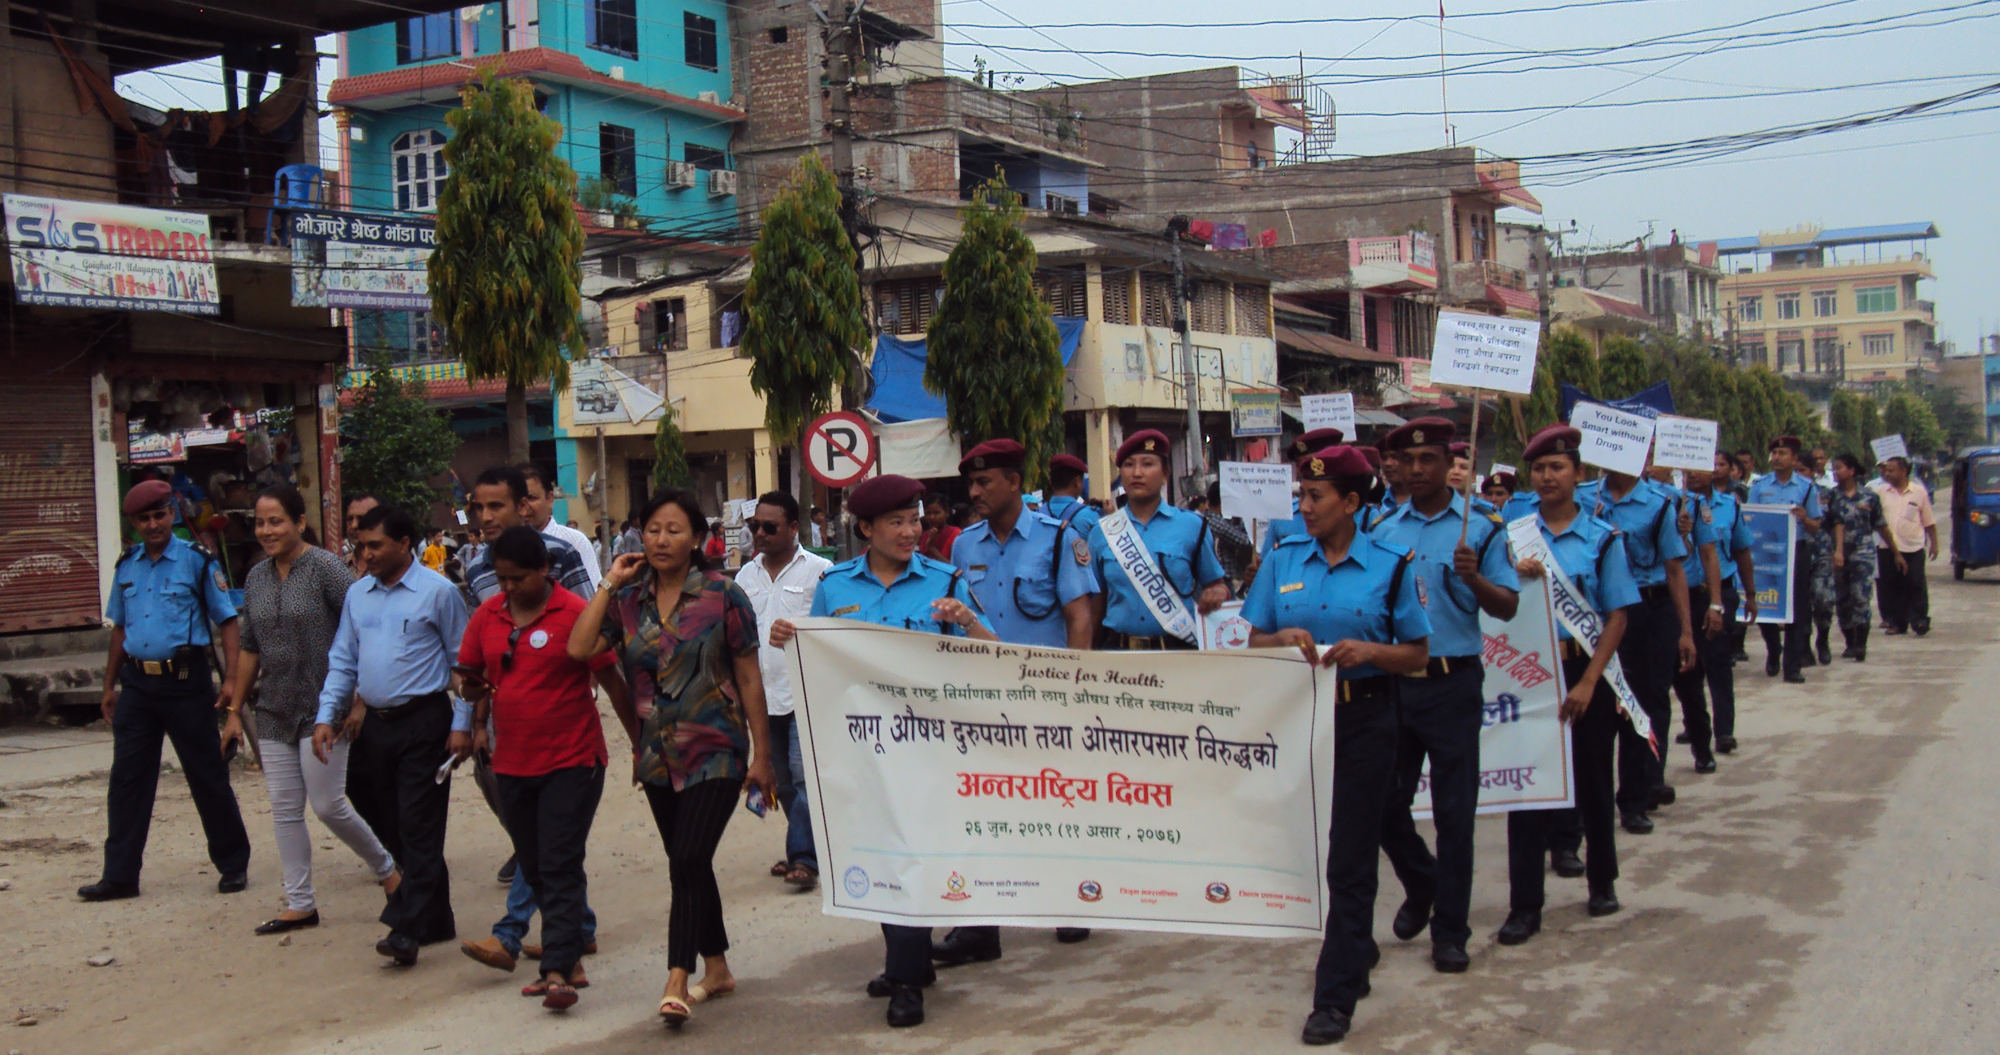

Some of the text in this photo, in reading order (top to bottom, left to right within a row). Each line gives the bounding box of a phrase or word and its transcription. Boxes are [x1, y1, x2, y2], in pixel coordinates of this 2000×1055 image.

[296, 213, 347, 241] भोजपुरे
[350, 219, 381, 240] श्रेष्ठ
[101, 224, 210, 263] TRADERS
[1581, 420, 1609, 434] Smart
[1610, 427, 1646, 443] without
[1595, 410, 1613, 422] You
[1615, 416, 1639, 428] Look
[825, 427, 857, 471] P
[1595, 437, 1624, 452] Drugs
[38, 504, 81, 523] PAINTS
[1116, 531, 1177, 615] सामुदायिक
[936, 641, 991, 656] Health
[995, 643, 1019, 658] for
[1018, 663, 1165, 688] Justice for Health:
[911, 686, 938, 702] राष्ट्र
[942, 683, 1001, 700] निर्माणका
[1006, 686, 1036, 701] लागि
[1041, 690, 1068, 706] लागु
[1073, 689, 1110, 706] औषध
[1114, 693, 1144, 709] रहित
[1149, 698, 1194, 714] स्वास्थ्य
[845, 704, 1279, 771] लागू औषध दुरुपयोग तथा ओसारपसार विरुद्धको
[956, 767, 1174, 809] अन्तराष्ट्रिय दिवस
[1479, 766, 1537, 791] दयपुर
[964, 820, 983, 836] २६
[1018, 822, 1052, 838] २०१९
[1086, 824, 1122, 840] असार
